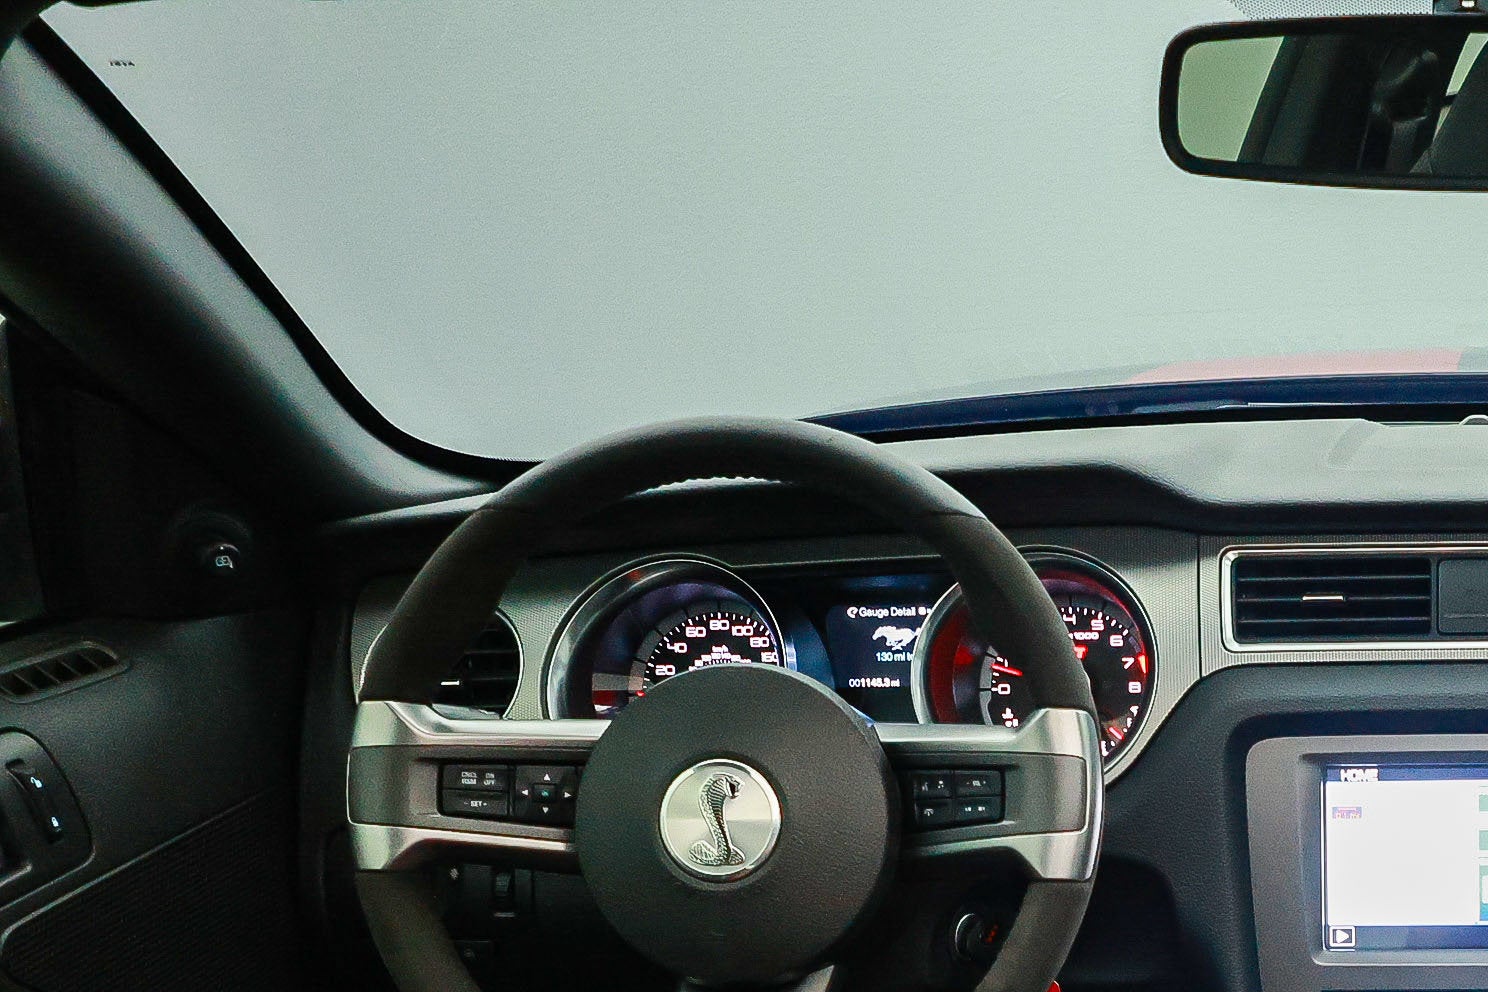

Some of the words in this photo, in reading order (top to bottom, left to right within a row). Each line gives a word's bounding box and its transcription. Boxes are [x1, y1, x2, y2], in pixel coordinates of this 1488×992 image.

[858, 606, 889, 618] Gauge
[890, 606, 916, 617] Detail
[709, 619, 730, 631] 80
[731, 625, 754, 637] 100
[1090, 619, 1104, 631] 5
[1109, 634, 1124, 647] 6
[666, 641, 688, 653] 40
[1121, 656, 1135, 670] 7
[655, 664, 676, 676] 20
[997, 683, 1011, 695] 0
[1128, 681, 1142, 694] 8
[1340, 768, 1379, 782] HOME
